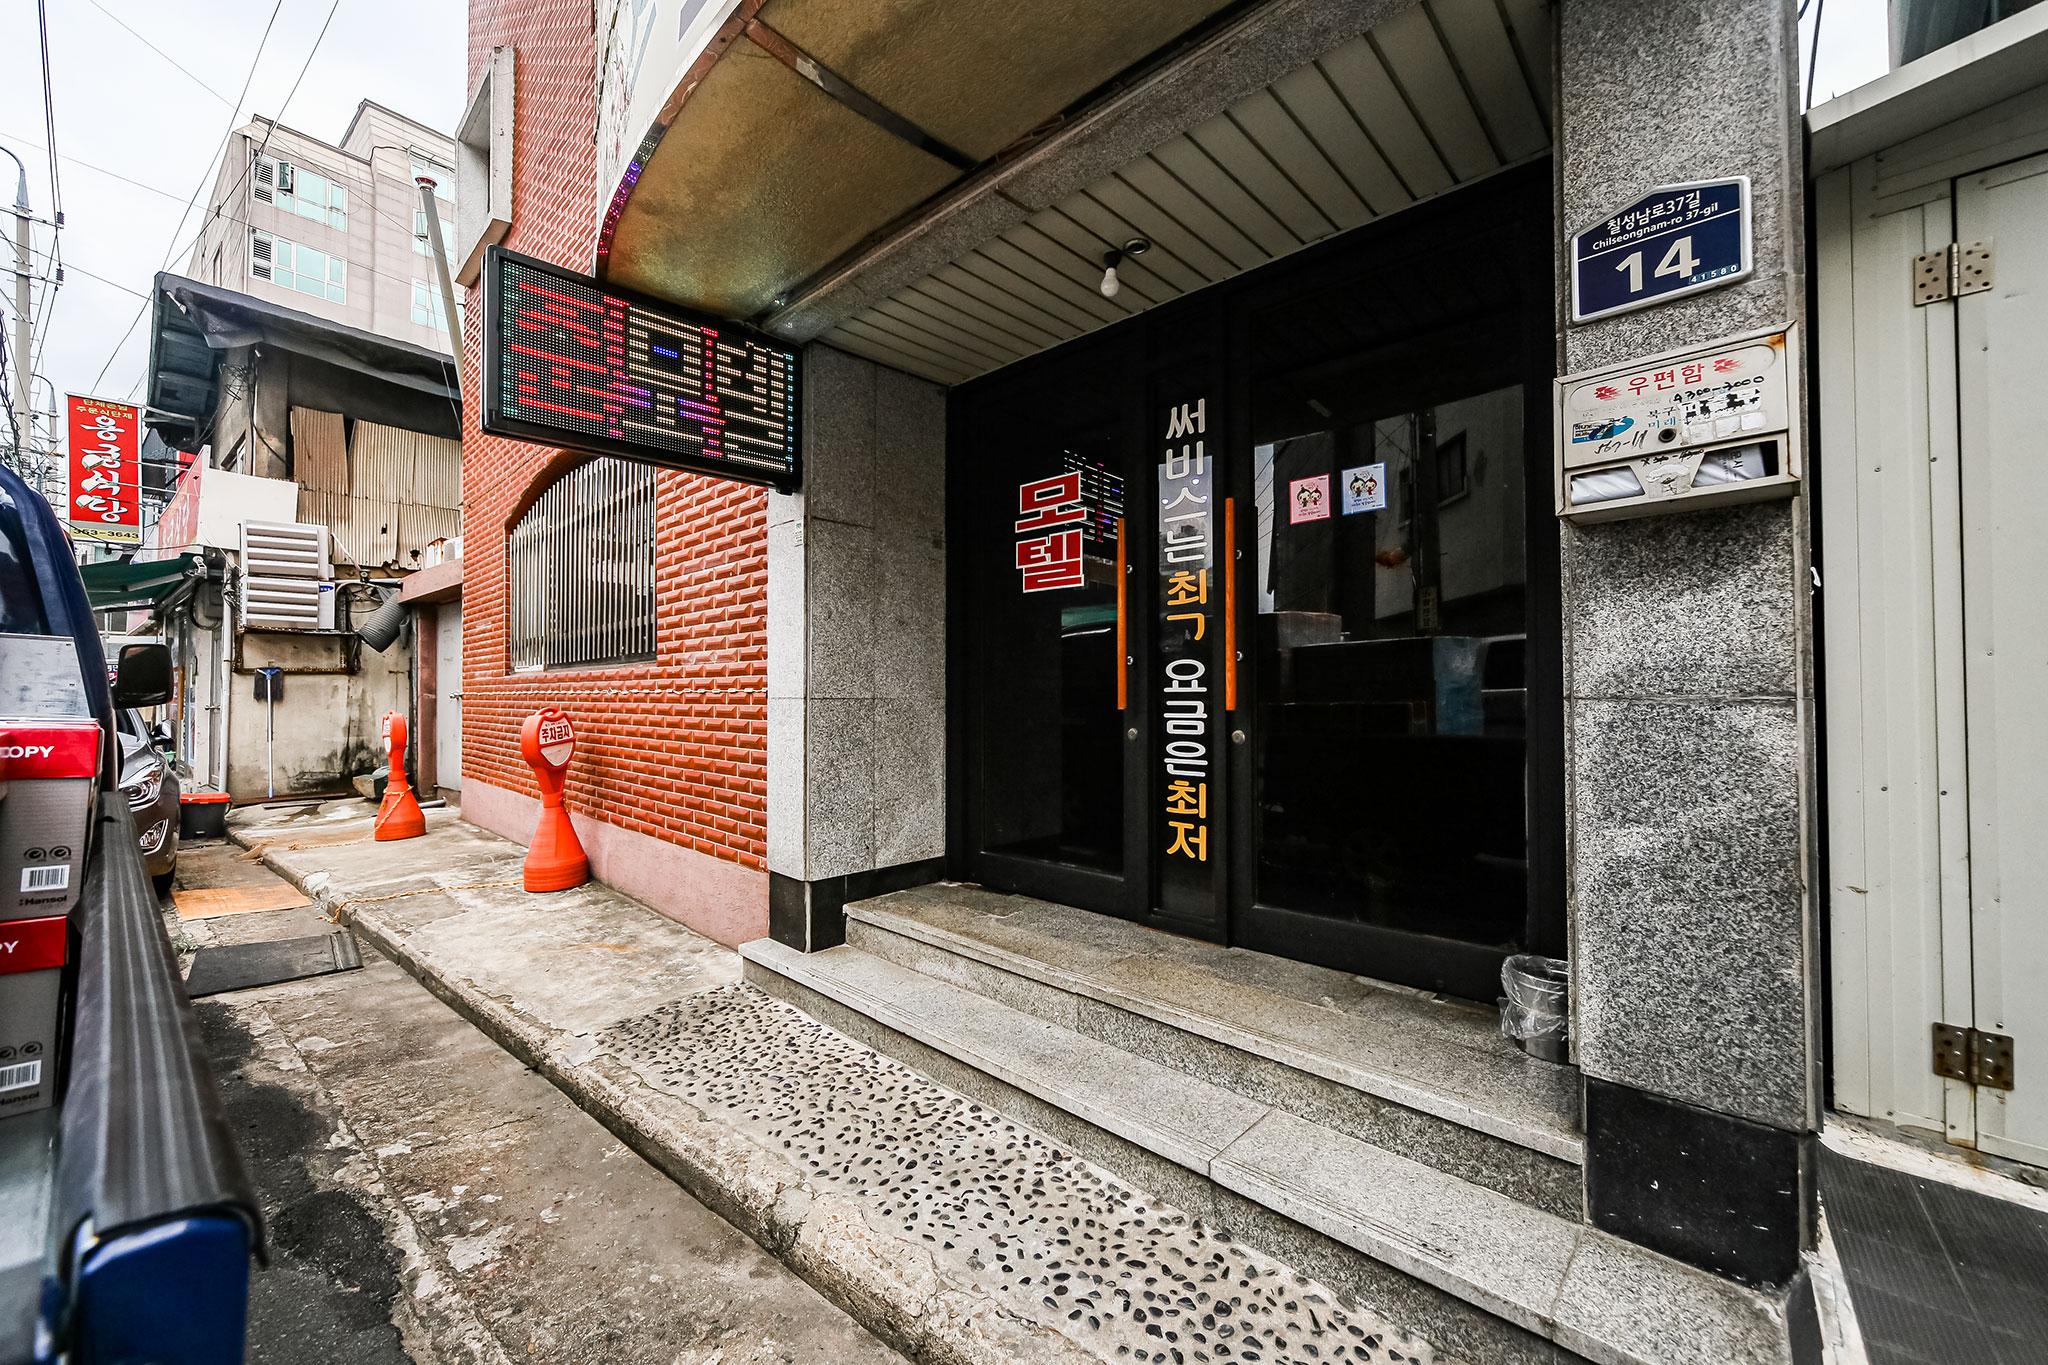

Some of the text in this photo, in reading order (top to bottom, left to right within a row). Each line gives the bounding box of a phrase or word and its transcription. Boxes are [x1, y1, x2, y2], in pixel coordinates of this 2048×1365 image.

[1592, 202, 1719, 251] Chilseongnam-ro 37-gil
[1608, 190, 1701, 234] 칠성남로37길
[1615, 235, 1701, 294] 14
[1690, 264, 1739, 283] 41580
[1626, 363, 1706, 395] 우편함
[1014, 471, 1088, 594] 모텔
[541, 724, 570, 743] 주차금지
[25, 894, 67, 906] Hansol
